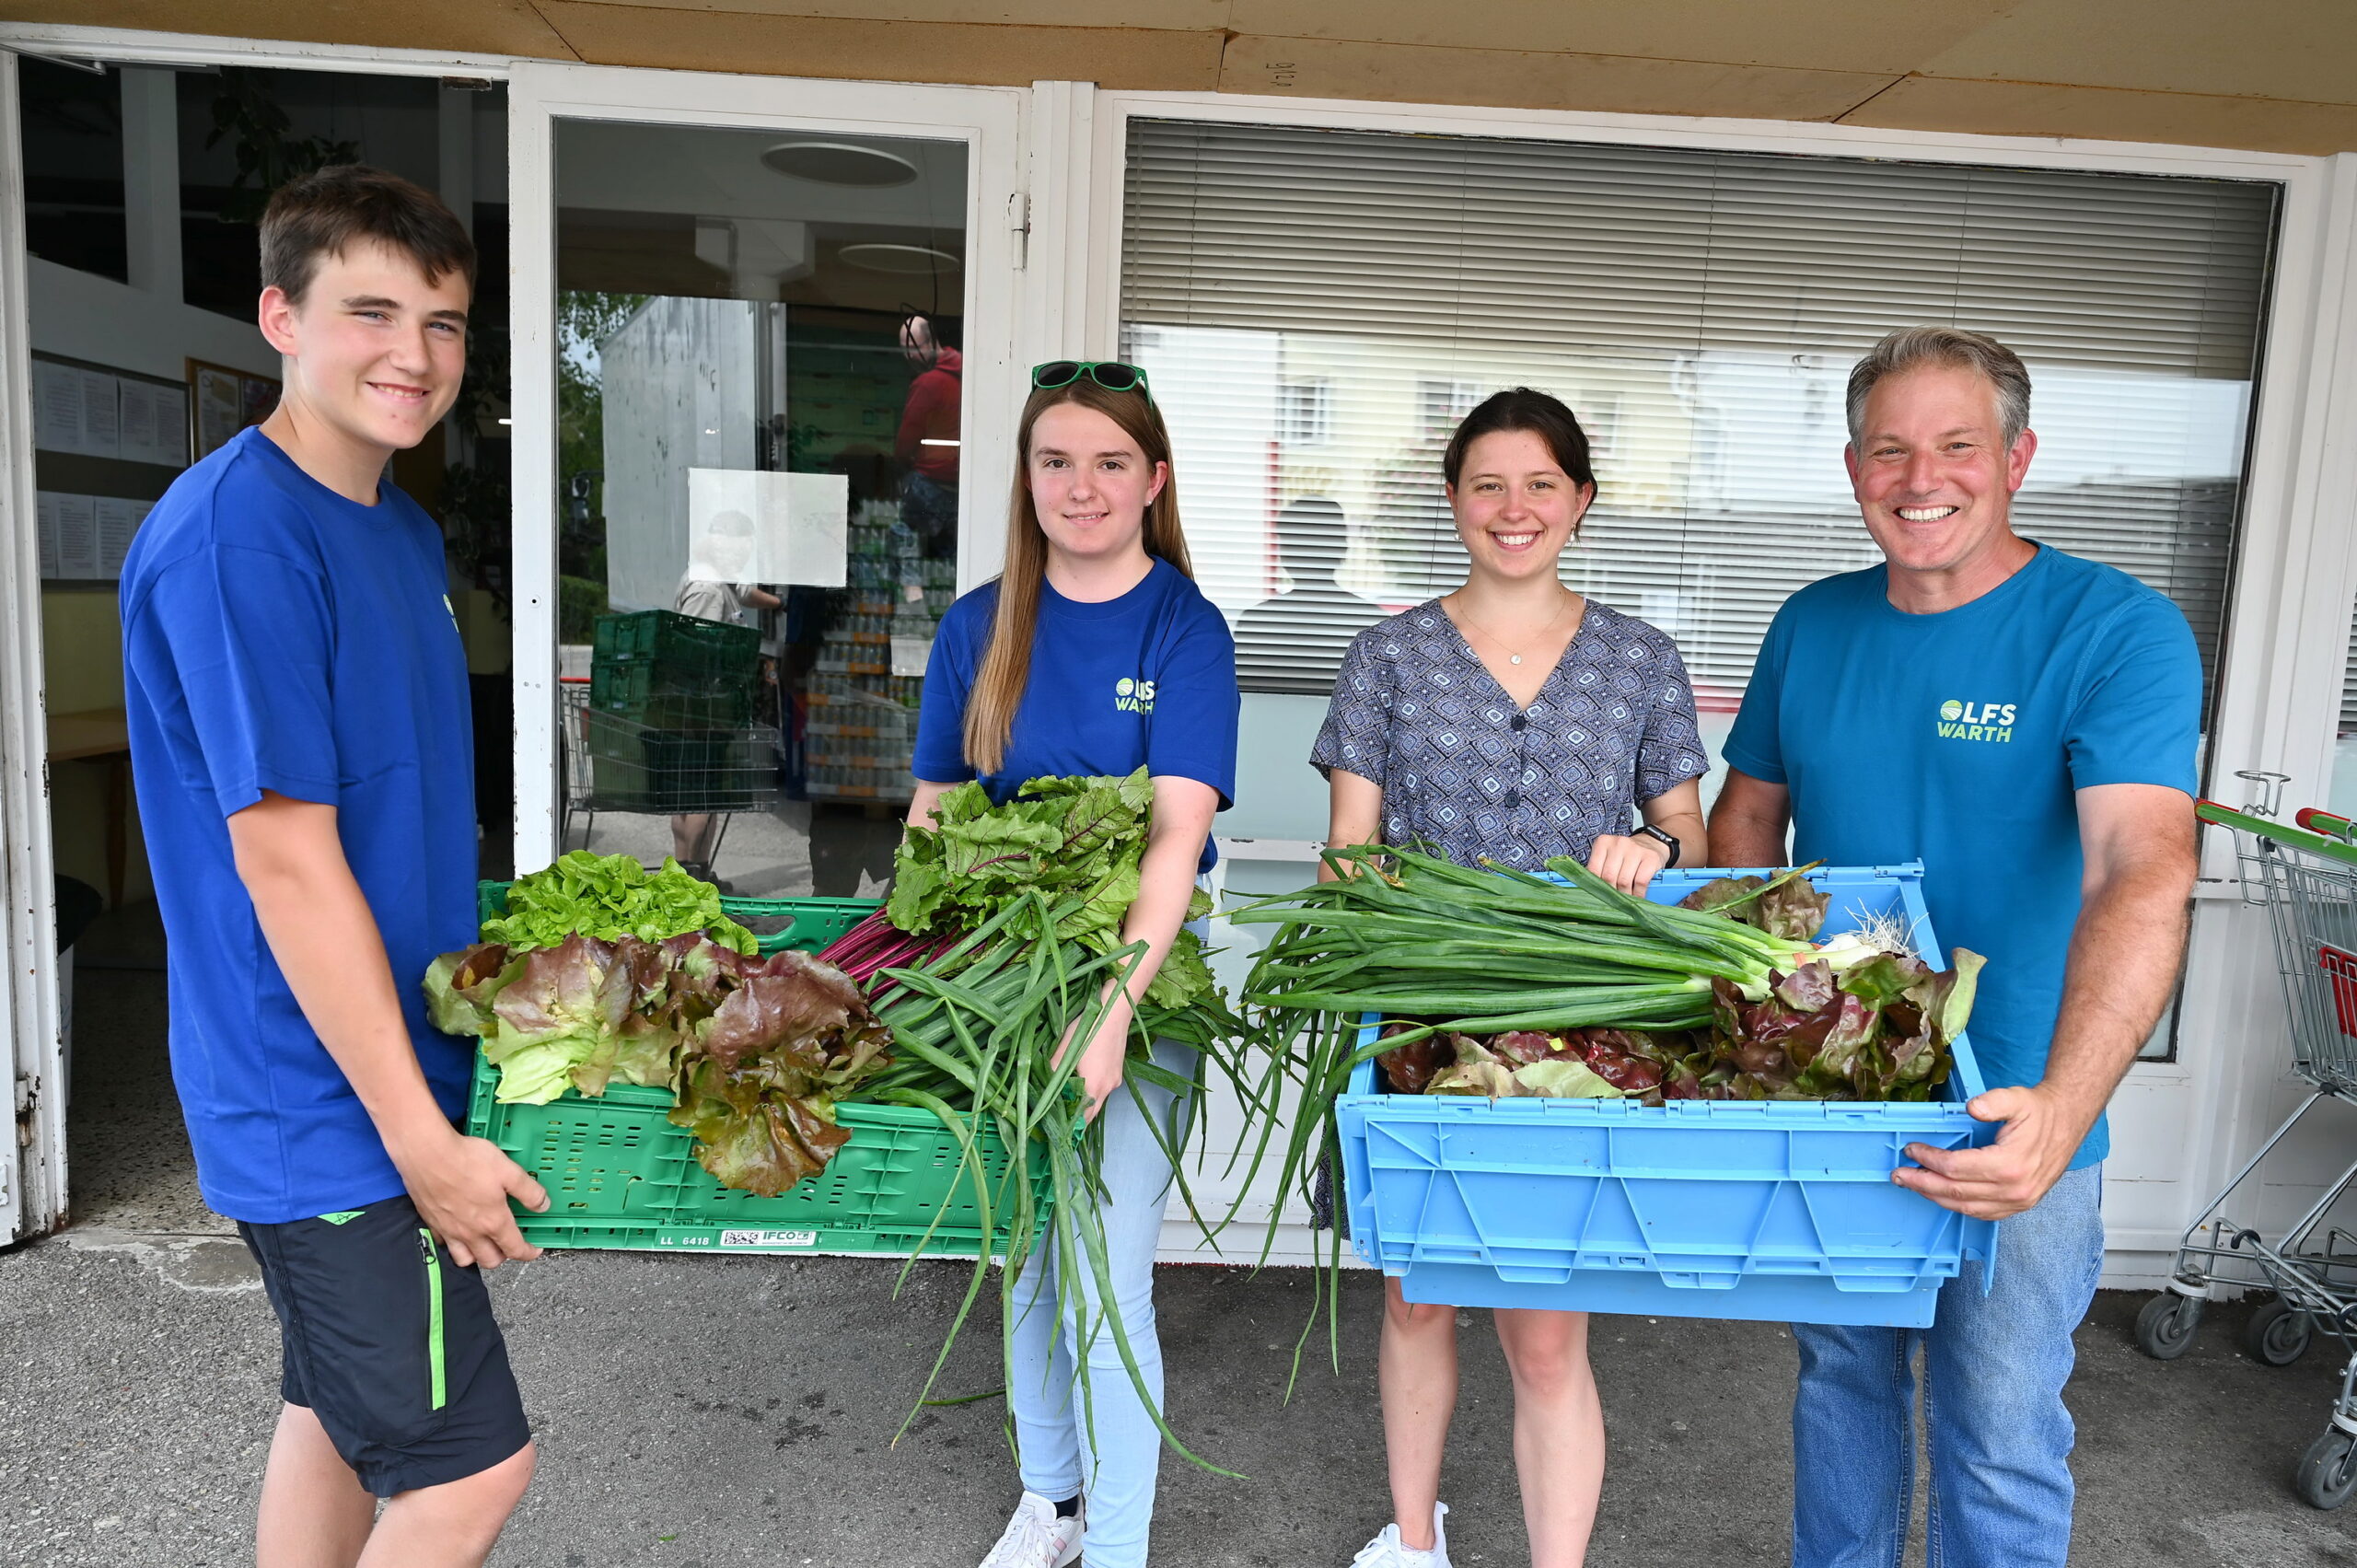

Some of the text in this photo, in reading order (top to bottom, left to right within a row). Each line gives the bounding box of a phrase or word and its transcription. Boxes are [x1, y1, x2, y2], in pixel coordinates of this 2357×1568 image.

[1962, 702, 2017, 726] LFS
[1937, 722, 2013, 743] WARTH
[660, 1237, 710, 1246] LL 6418
[762, 1231, 796, 1240] IFCO
